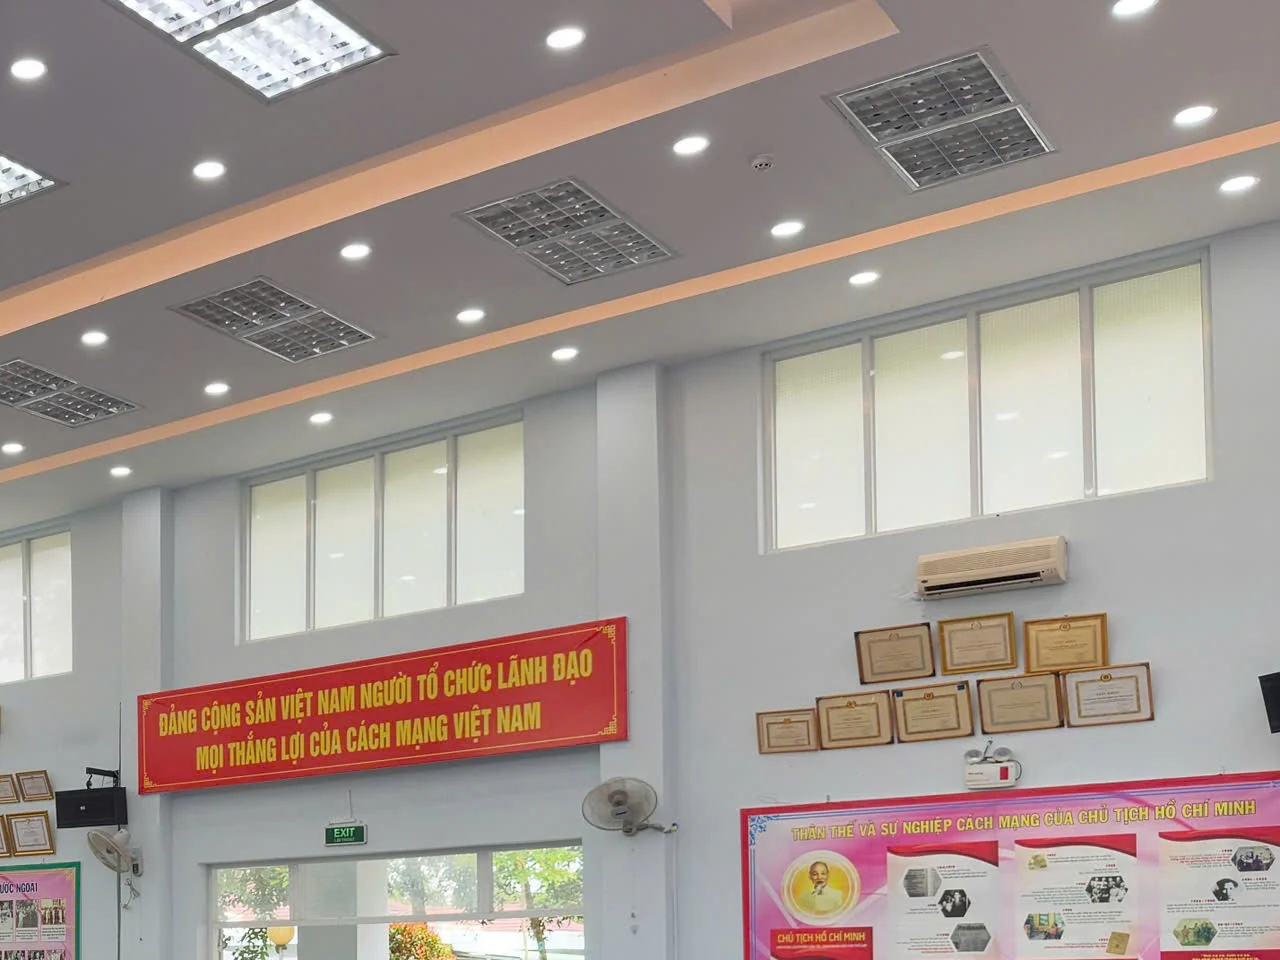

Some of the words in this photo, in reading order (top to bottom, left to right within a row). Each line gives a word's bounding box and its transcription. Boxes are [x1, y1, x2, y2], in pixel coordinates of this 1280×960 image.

[159, 703, 197, 737] ĐẢNG
[201, 701, 241, 735] CỘNG
[245, 691, 276, 725] SẢN
[280, 688, 313, 724] VIỆT
[318, 685, 355, 715] NAM
[360, 671, 412, 709] NGƯỜI
[417, 661, 439, 701] TỔ
[444, 660, 492, 697] CHỨC
[497, 654, 547, 690] LÃNH
[552, 648, 593, 685] ĐẠO
[196, 743, 224, 774] MỌI
[228, 731, 276, 767] THẮNG
[280, 732, 305, 765] LỢI
[310, 722, 342, 758] CỦA
[346, 720, 391, 752] CÁCH
[395, 714, 448, 750] MẠNG
[453, 704, 491, 743] VIỆT
[497, 702, 541, 734] NAM
[334, 827, 355, 838] EXIT
[830, 819, 857, 839] THẾ
[859, 819, 876, 837] VÀ
[881, 819, 899, 838] SỰ
[903, 815, 953, 836] NGHIỆP
[956, 813, 993, 831] CÁCH
[998, 813, 1040, 832] MẠNG
[1044, 807, 1074, 826] CỦA
[1079, 804, 1109, 824] CHỦ
[1115, 807, 1149, 825] TỊCH
[1154, 799, 1176, 820] HỒ
[1182, 799, 1210, 818] CHÍ
[1214, 799, 1256, 817] MINH
[777, 931, 794, 943] CHỦ
[796, 932, 814, 943] TỊCH
[815, 930, 827, 942] HỒ
[829, 930, 843, 942] CHÍ
[843, 931, 866, 941] MINH
